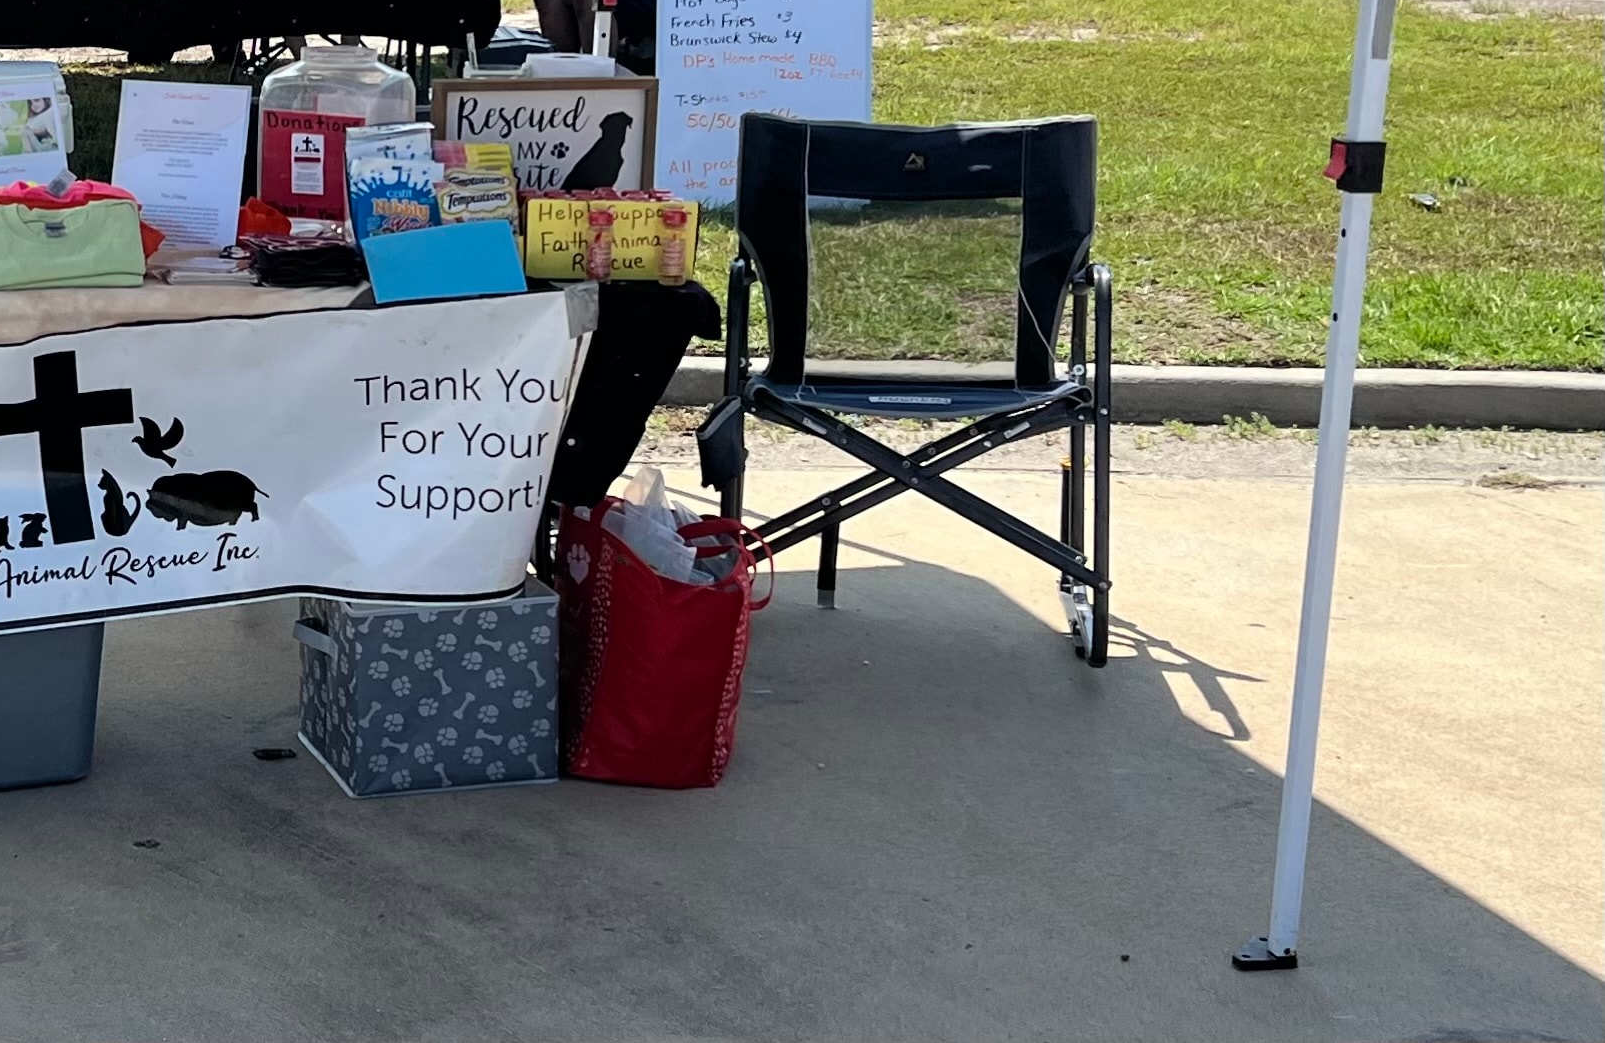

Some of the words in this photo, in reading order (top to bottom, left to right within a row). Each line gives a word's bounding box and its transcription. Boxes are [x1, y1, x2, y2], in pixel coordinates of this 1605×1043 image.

[671, 14, 715, 29] French
[721, 12, 756, 29] Fries
[670, 31, 741, 47] Brunswick
[748, 31, 778, 44] Stew
[683, 53, 715, 68] DP's
[809, 52, 837, 67] BBQ
[457, 95, 590, 139] Rescued
[686, 111, 736, 133] 50/50
[517, 141, 547, 161] MY
[513, 163, 563, 192] rite
[669, 159, 691, 175] All
[703, 160, 736, 176] proc
[683, 178, 707, 190] the
[447, 191, 508, 211] Temptations
[538, 203, 585, 227] Help
[541, 231, 588, 255] Faith
[572, 253, 646, 272] Rcue
[353, 367, 482, 406] Thank
[496, 368, 568, 404] You
[380, 421, 445, 455] For
[457, 422, 549, 459] Your
[375, 474, 544, 520] Support!
[101, 546, 209, 586] Rescue
[211, 532, 261, 573] Inc.
